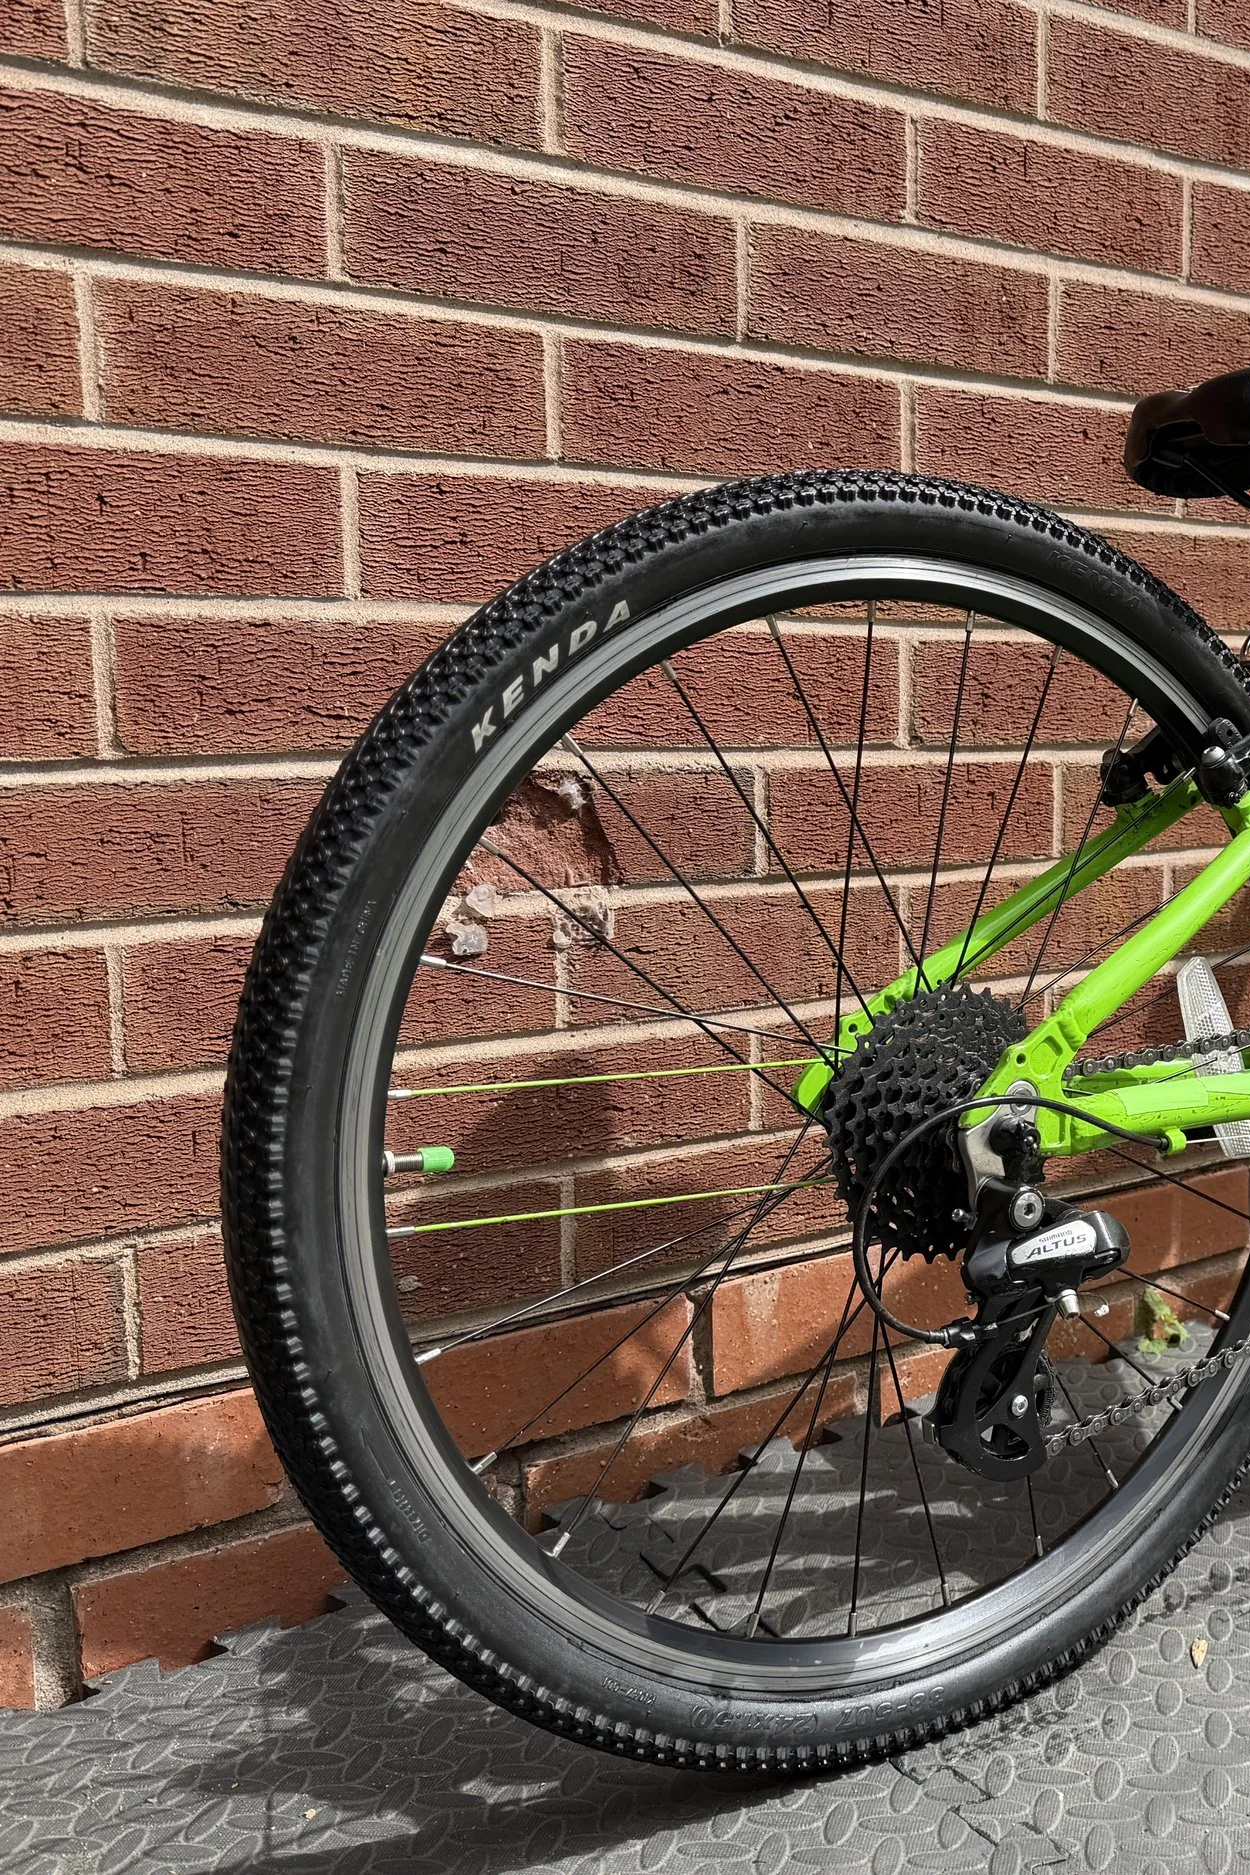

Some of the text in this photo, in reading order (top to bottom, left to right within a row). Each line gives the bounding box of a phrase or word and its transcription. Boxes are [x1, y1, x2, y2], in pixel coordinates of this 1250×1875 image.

[471, 600, 631, 753] KENDA
[347, 939, 361, 957] IN
[357, 900, 378, 935] CHINA
[1025, 1233, 1087, 1261] ALTUS
